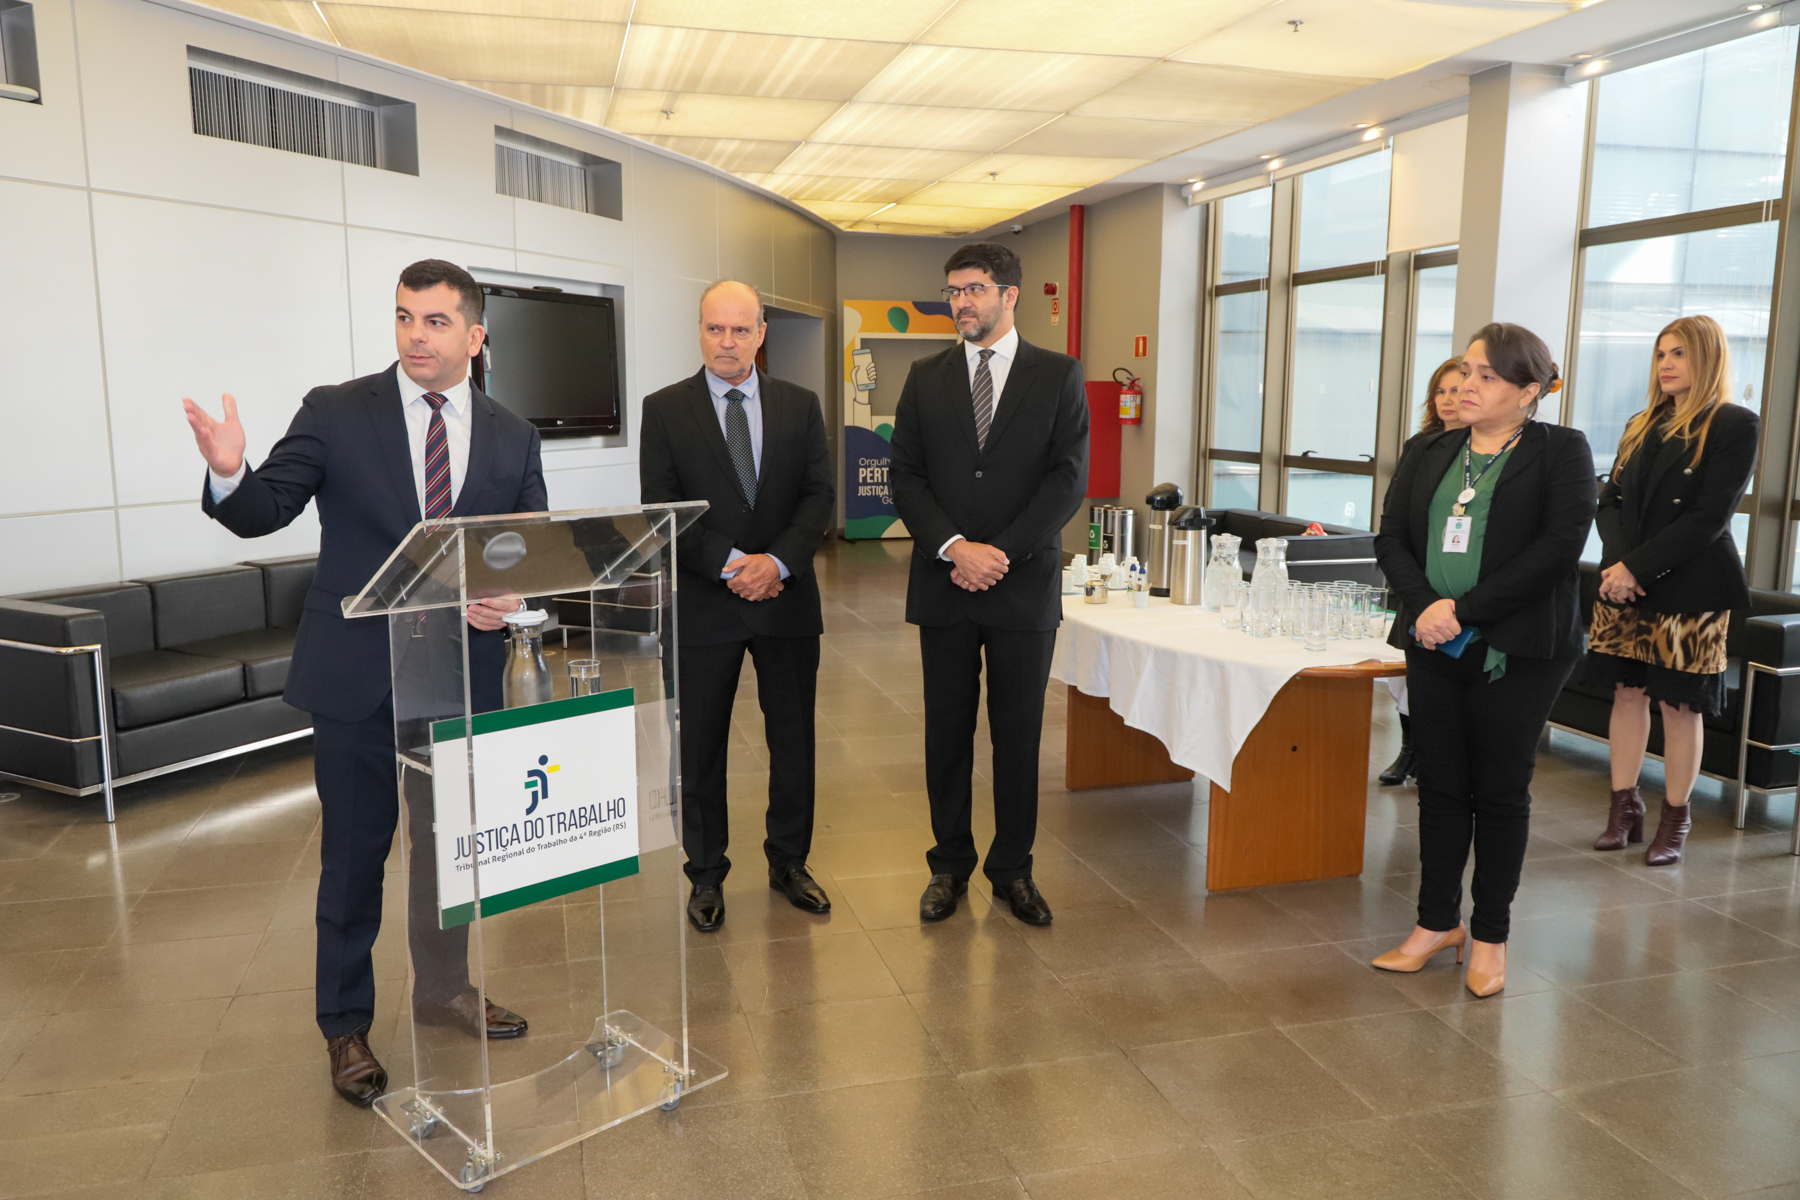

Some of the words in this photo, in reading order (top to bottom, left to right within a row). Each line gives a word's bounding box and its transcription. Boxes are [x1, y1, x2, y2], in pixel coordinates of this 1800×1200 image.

[859, 467, 889, 483] PERT
[857, 485, 889, 498] JUSTIÇA
[454, 823, 521, 861] JUSTIÇA
[524, 817, 544, 842] DO
[546, 797, 626, 836] TRABALHO
[492, 848, 525, 863] Regional
[526, 846, 536, 854] do
[537, 839, 568, 850] Trabalho
[588, 826, 612, 837] Região
[612, 821, 627, 832] (RS)
